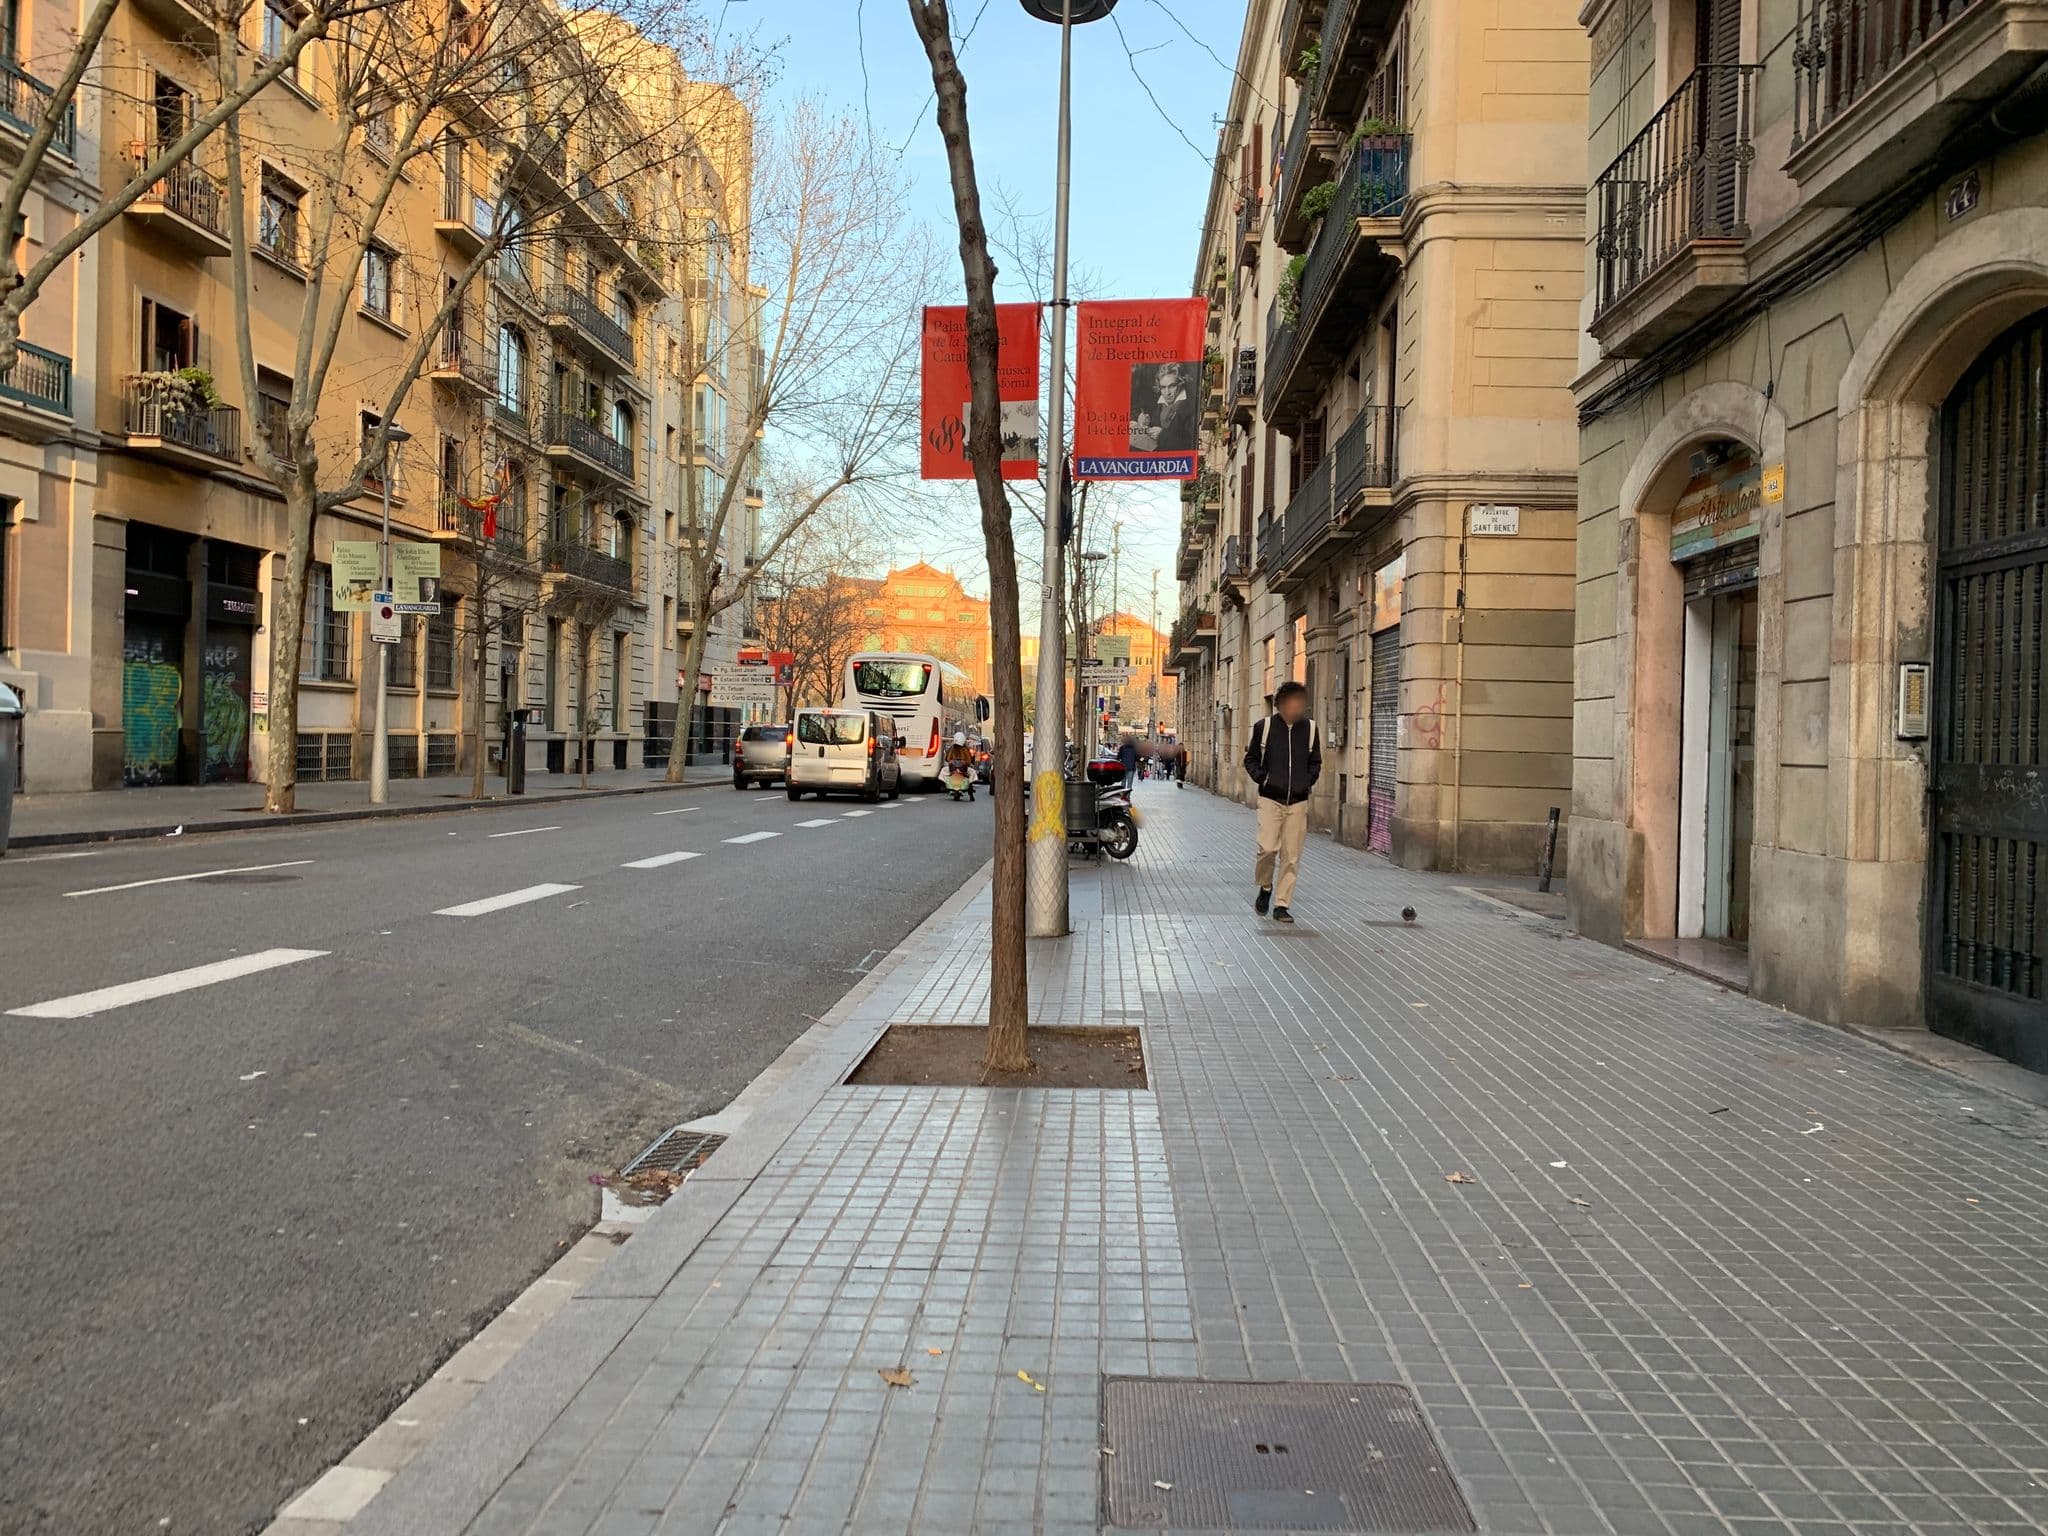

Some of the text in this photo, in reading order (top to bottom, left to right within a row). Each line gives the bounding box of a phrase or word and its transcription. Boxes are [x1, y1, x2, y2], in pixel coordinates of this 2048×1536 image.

[1088, 314, 1160, 330] Integral de
[949, 336, 962, 348] la
[1088, 331, 1157, 344] Simfonies
[1088, 347, 1178, 360] de Beethoven
[1086, 412, 1105, 422] Del
[1110, 412, 1116, 422] 9
[1086, 424, 1149, 435] 14 de febrer
[1081, 460, 1190, 474] LA VANGUARDIA
[1474, 524, 1516, 532] SANT BENET
